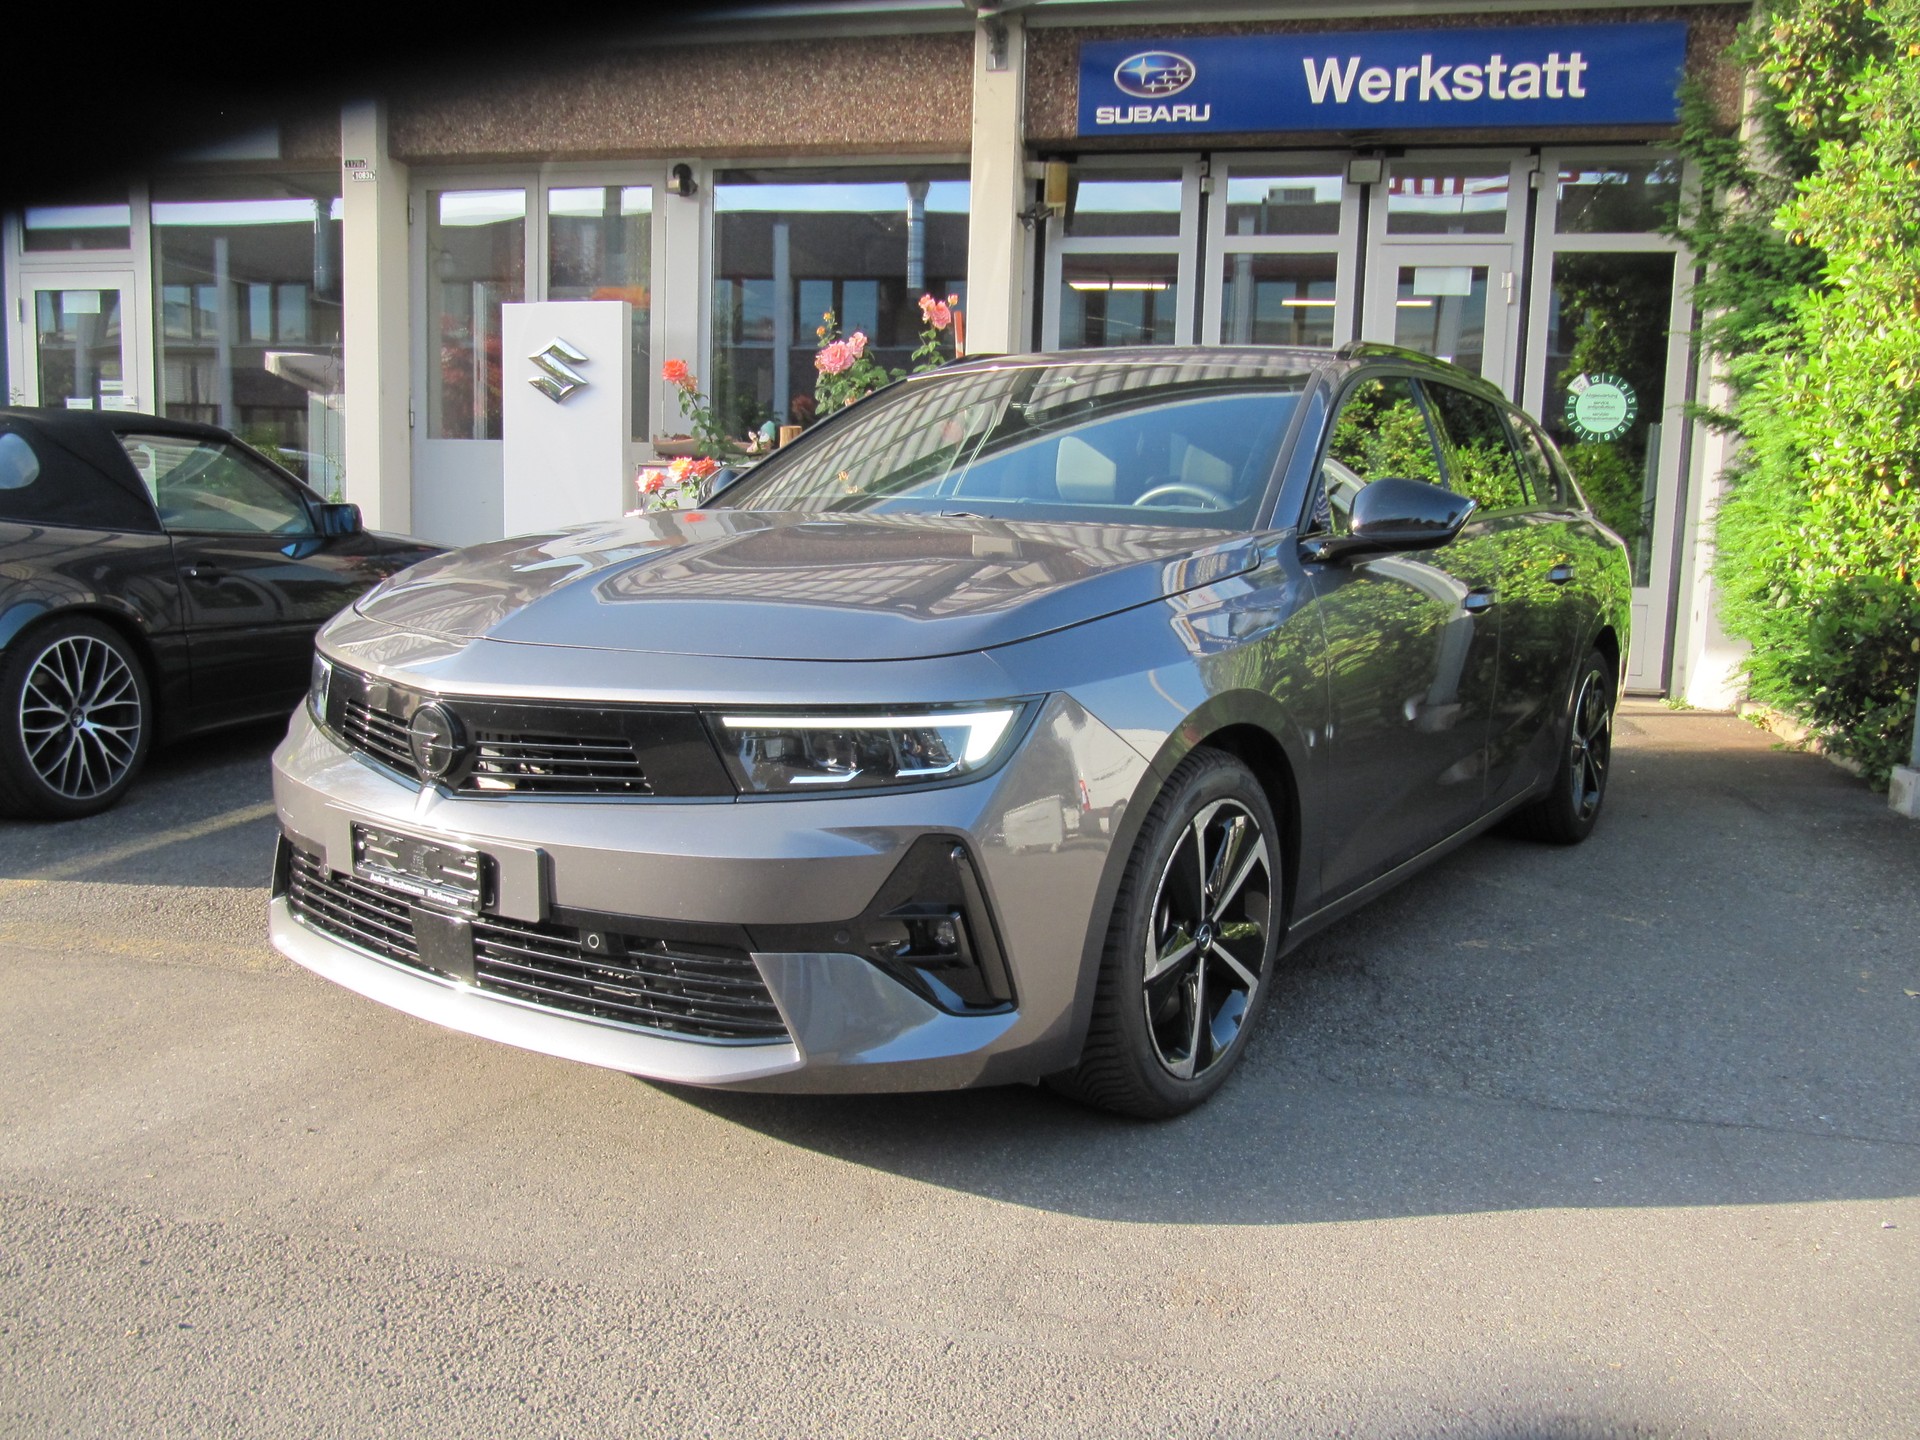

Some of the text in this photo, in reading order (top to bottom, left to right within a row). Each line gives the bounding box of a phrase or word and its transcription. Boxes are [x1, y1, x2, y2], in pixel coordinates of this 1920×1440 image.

[1303, 52, 1588, 104] Werkstatt
[1095, 104, 1211, 124] SUBARU
[1590, 375, 1600, 384] 12
[1620, 383, 1628, 391] 2
[1568, 395, 1576, 405] 10
[1618, 425, 1625, 433] 5
[427, 889, 459, 906] Rotkreuz
